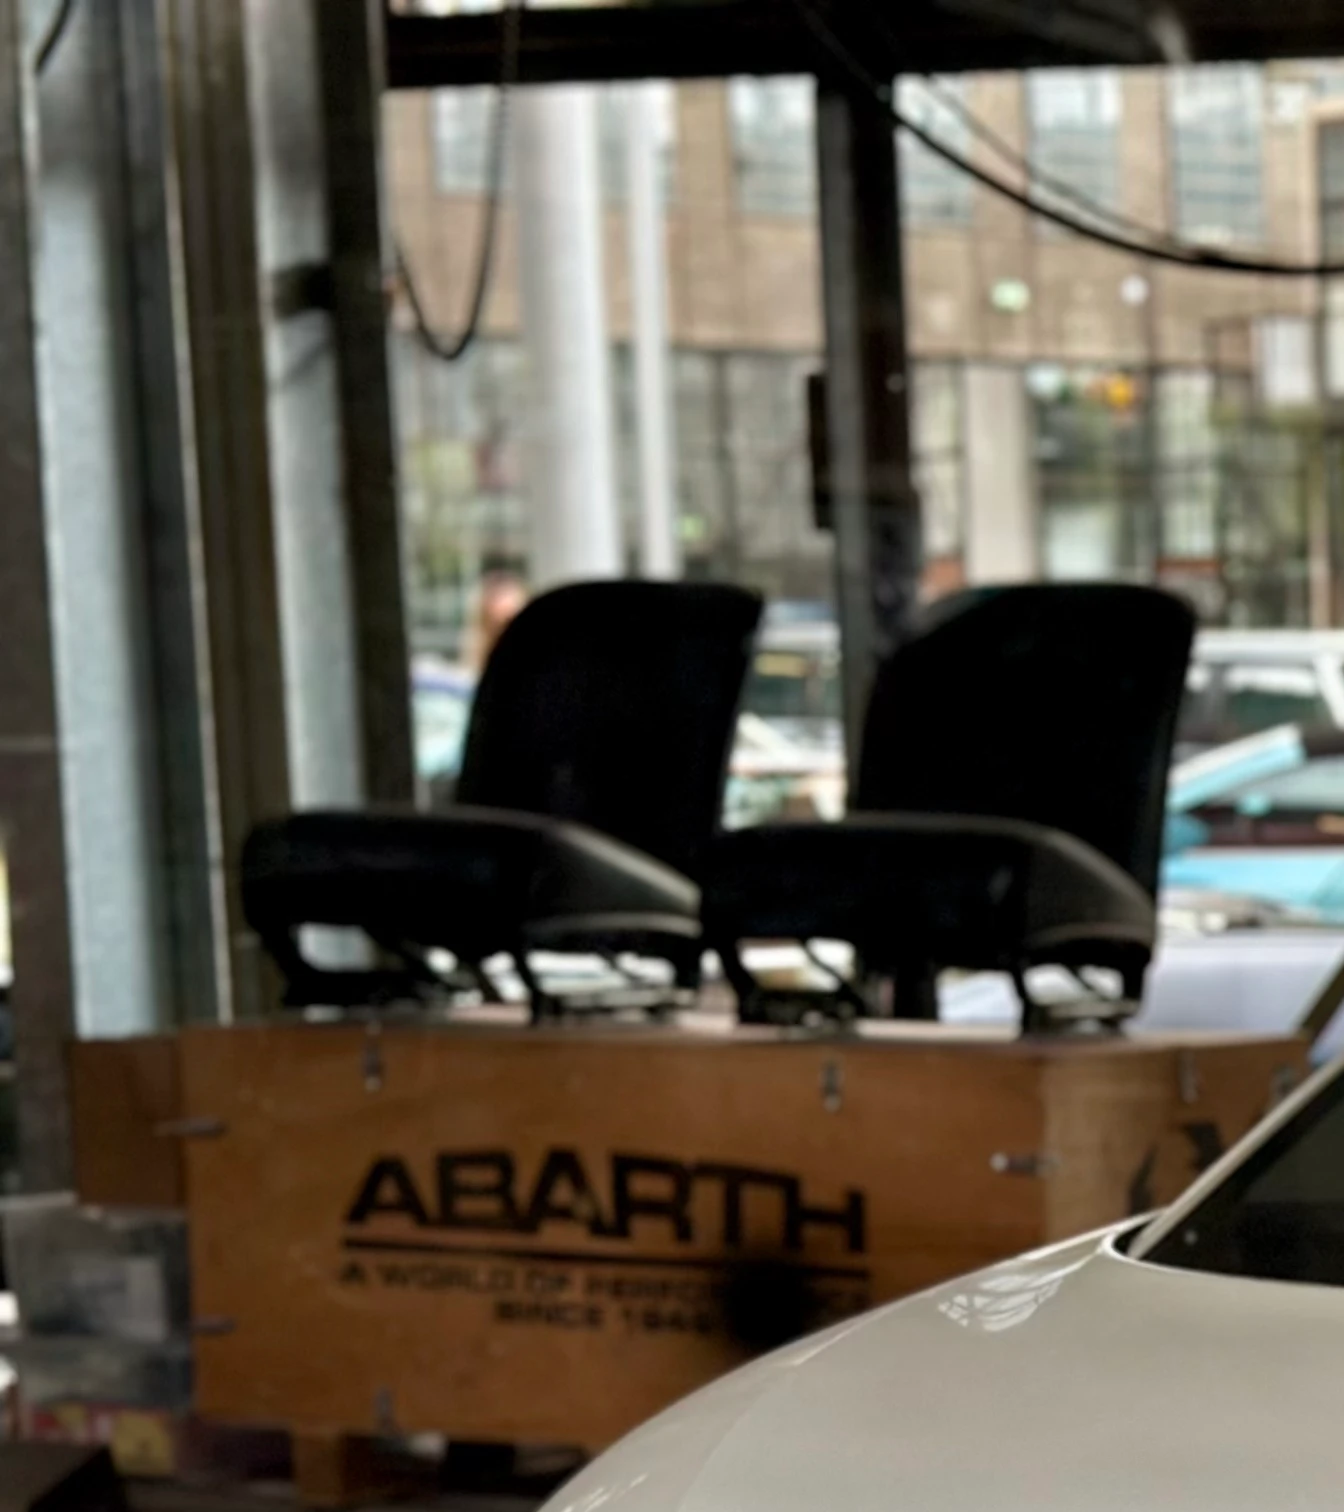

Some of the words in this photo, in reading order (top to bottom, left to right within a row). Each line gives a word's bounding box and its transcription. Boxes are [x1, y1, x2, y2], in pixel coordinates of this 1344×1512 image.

[344, 1149, 866, 1253] ABARTH
[340, 1261, 367, 1285] A
[493, 1299, 605, 1330] SINCE
